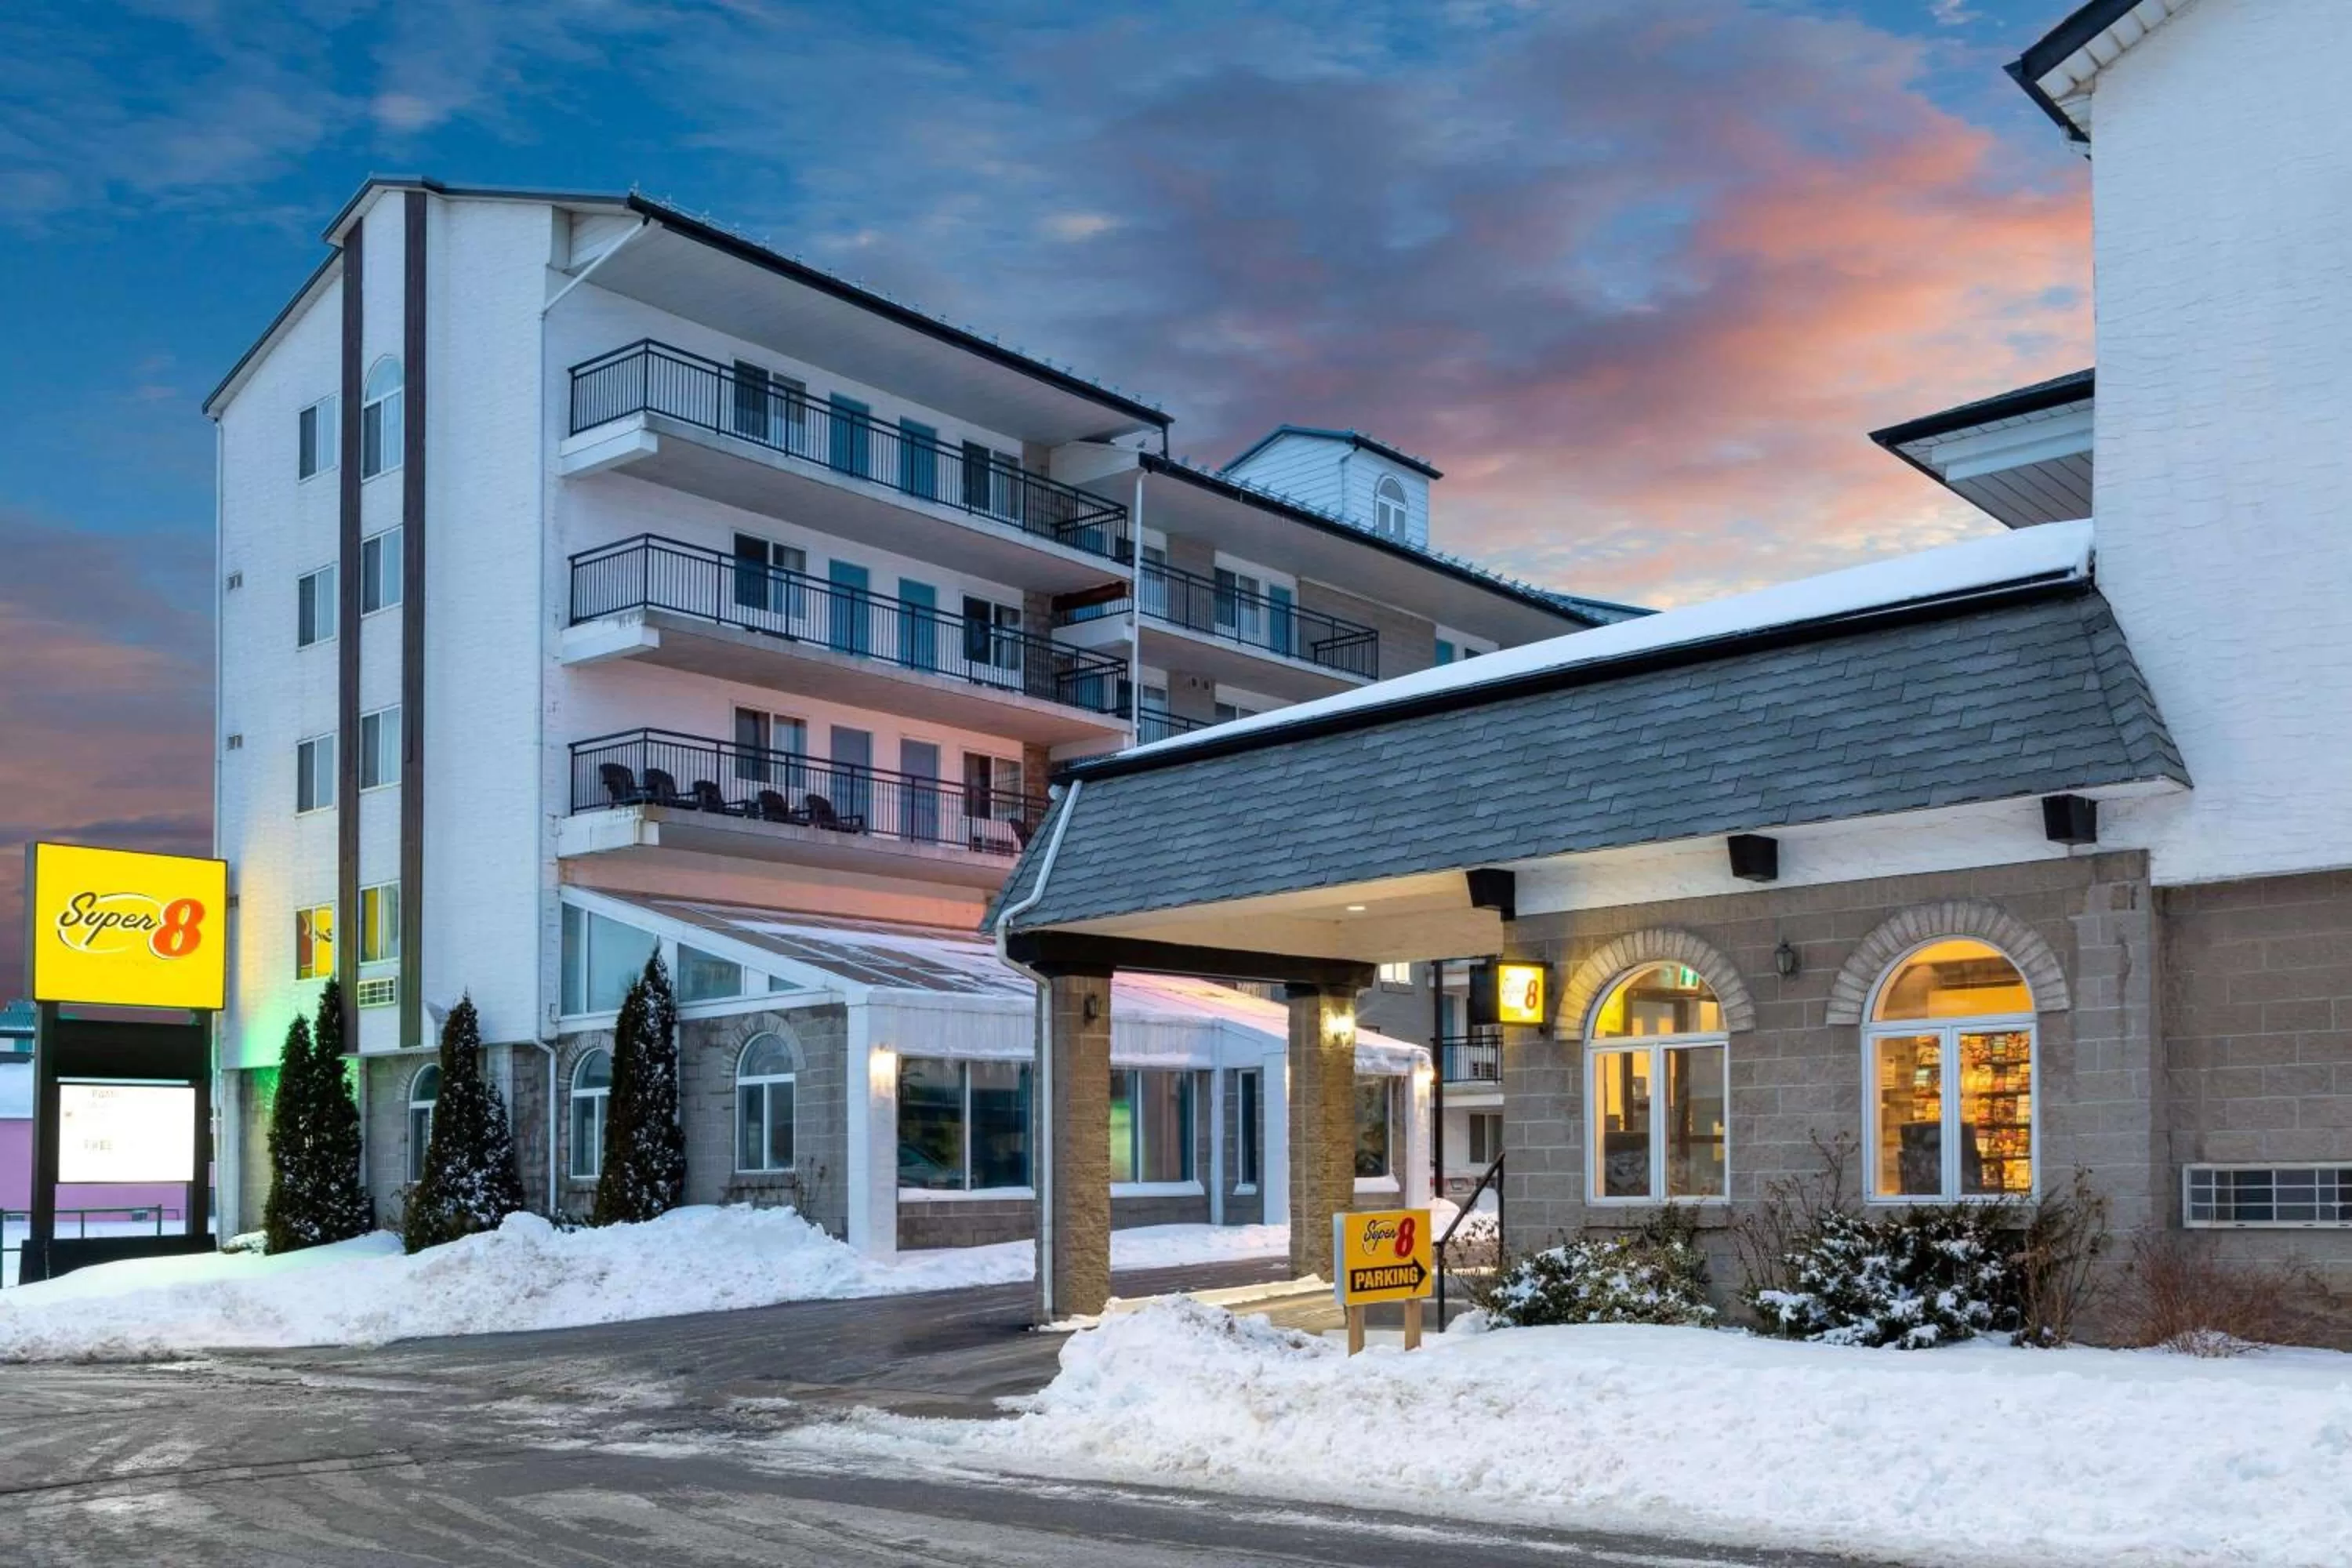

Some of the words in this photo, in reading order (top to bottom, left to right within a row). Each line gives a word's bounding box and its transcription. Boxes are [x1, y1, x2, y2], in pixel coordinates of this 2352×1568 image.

[60, 892, 158, 946] Super
[153, 898, 205, 957] 8
[1526, 980, 1537, 1009] 8
[1364, 1219, 1396, 1251] Super
[1396, 1218, 1415, 1258] 8
[1355, 1267, 1418, 1289] PARKING
